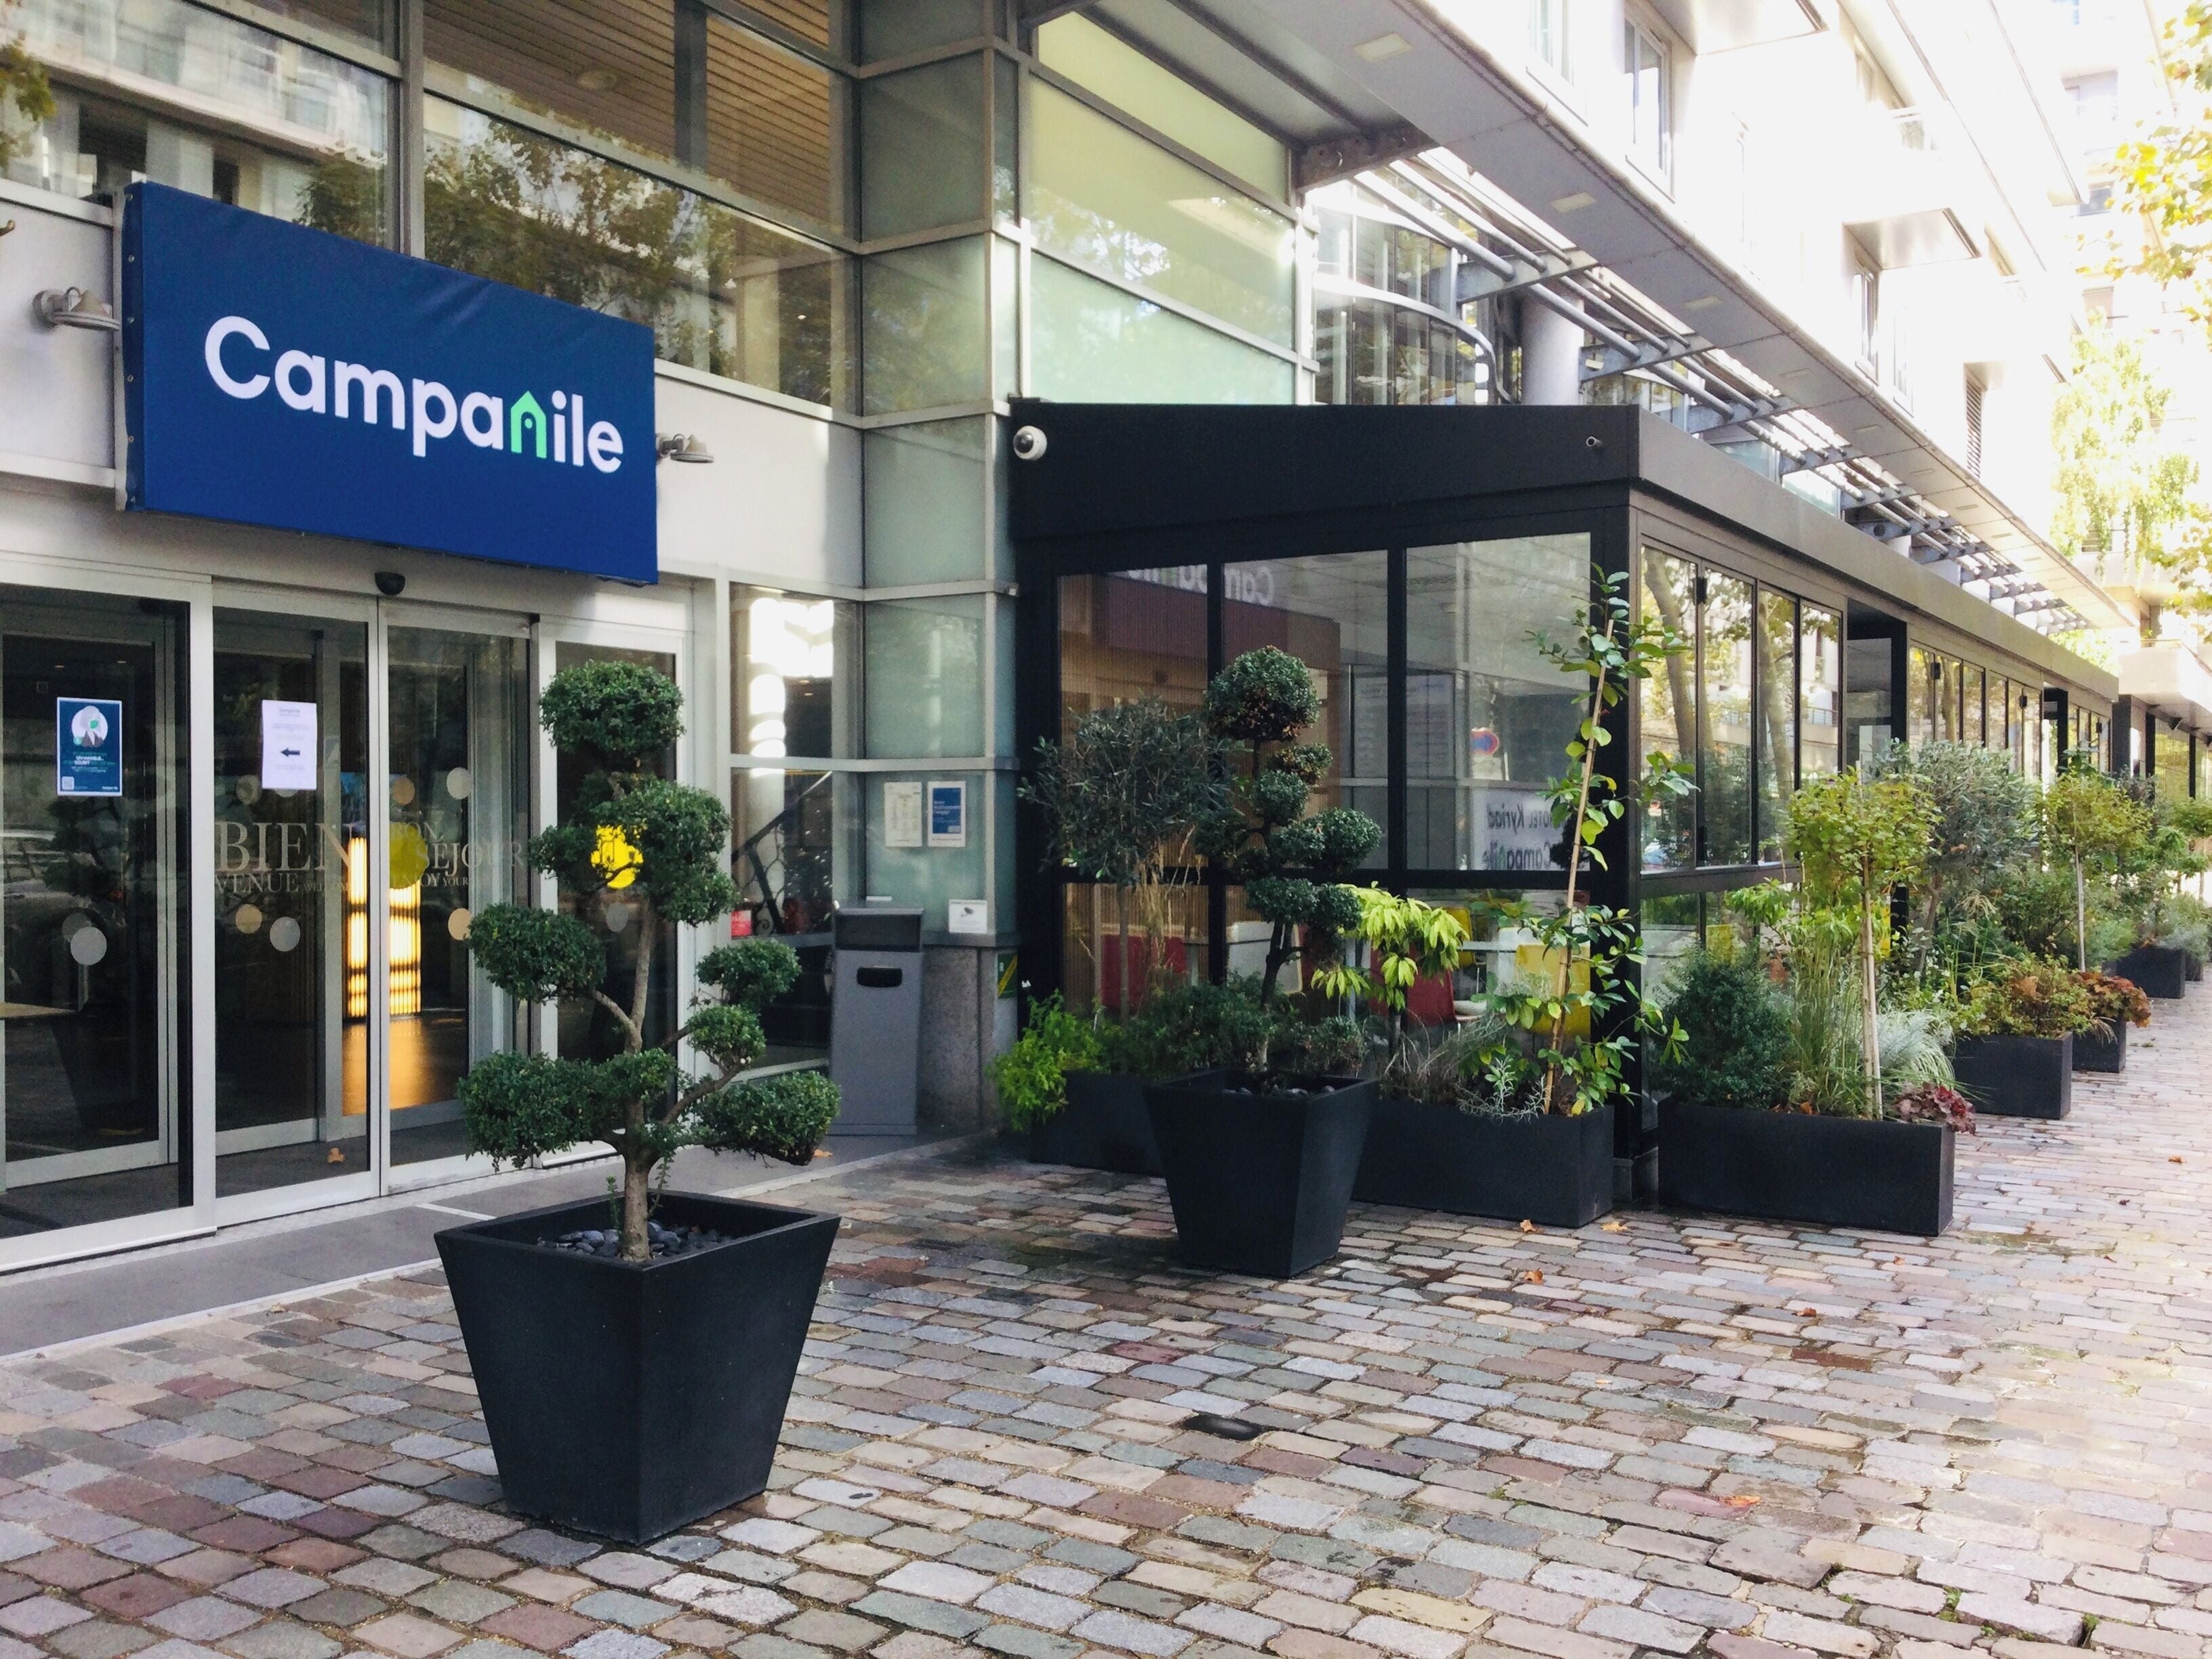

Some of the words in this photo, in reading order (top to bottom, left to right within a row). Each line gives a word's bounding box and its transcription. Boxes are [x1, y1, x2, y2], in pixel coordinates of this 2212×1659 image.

[205, 316, 623, 473] Campanile
[215, 821, 367, 872] BIEN
[215, 873, 299, 894] VENUE
